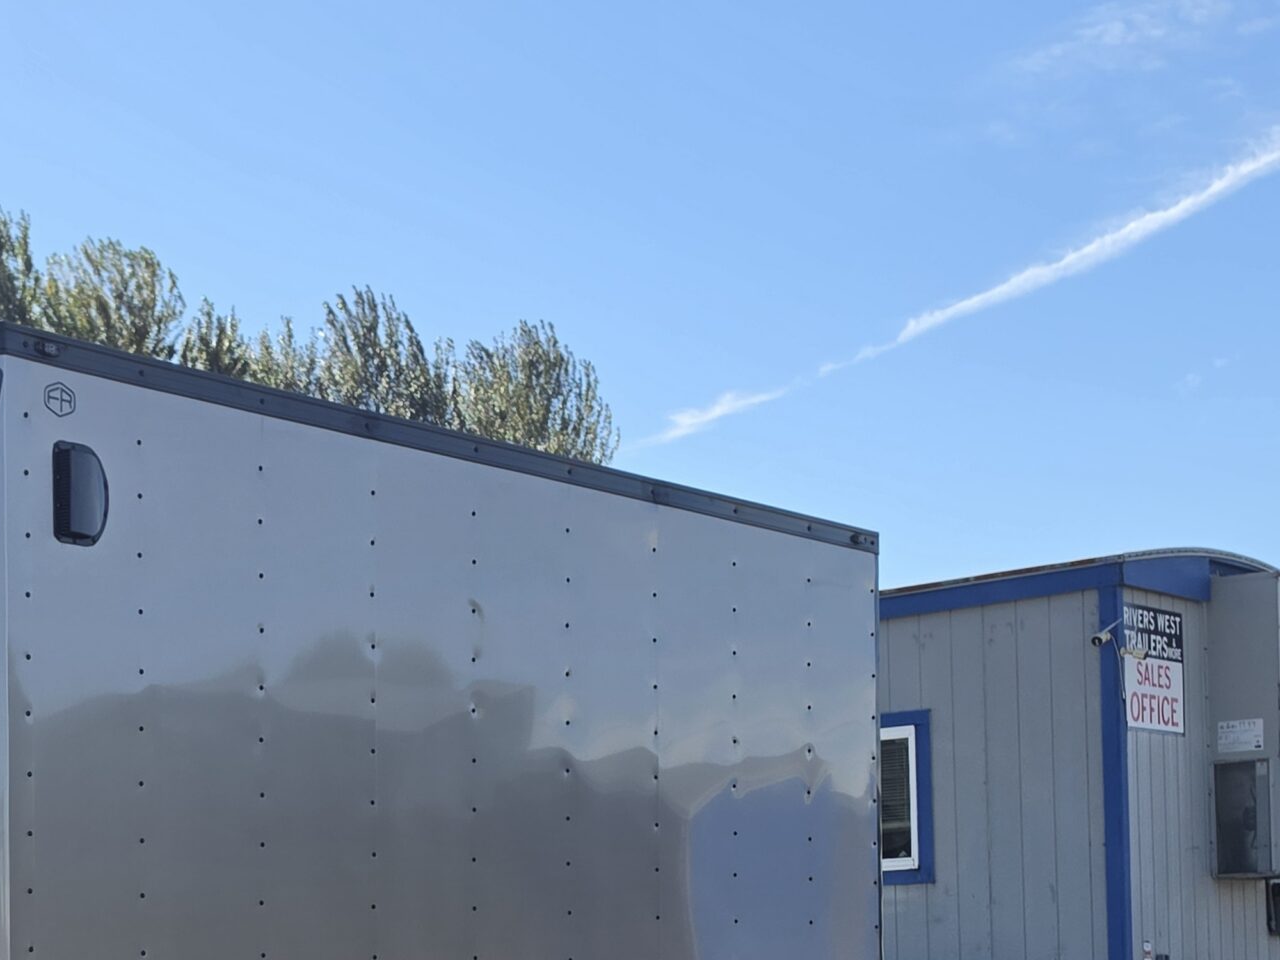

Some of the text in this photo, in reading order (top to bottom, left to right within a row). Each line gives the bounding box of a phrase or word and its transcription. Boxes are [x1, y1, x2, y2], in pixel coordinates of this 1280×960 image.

[1123, 606, 1181, 635] RIVERS WEST
[1124, 629, 1168, 659] TRAILERS
[1136, 661, 1171, 690] SALES
[1130, 691, 1179, 727] OFFICE
